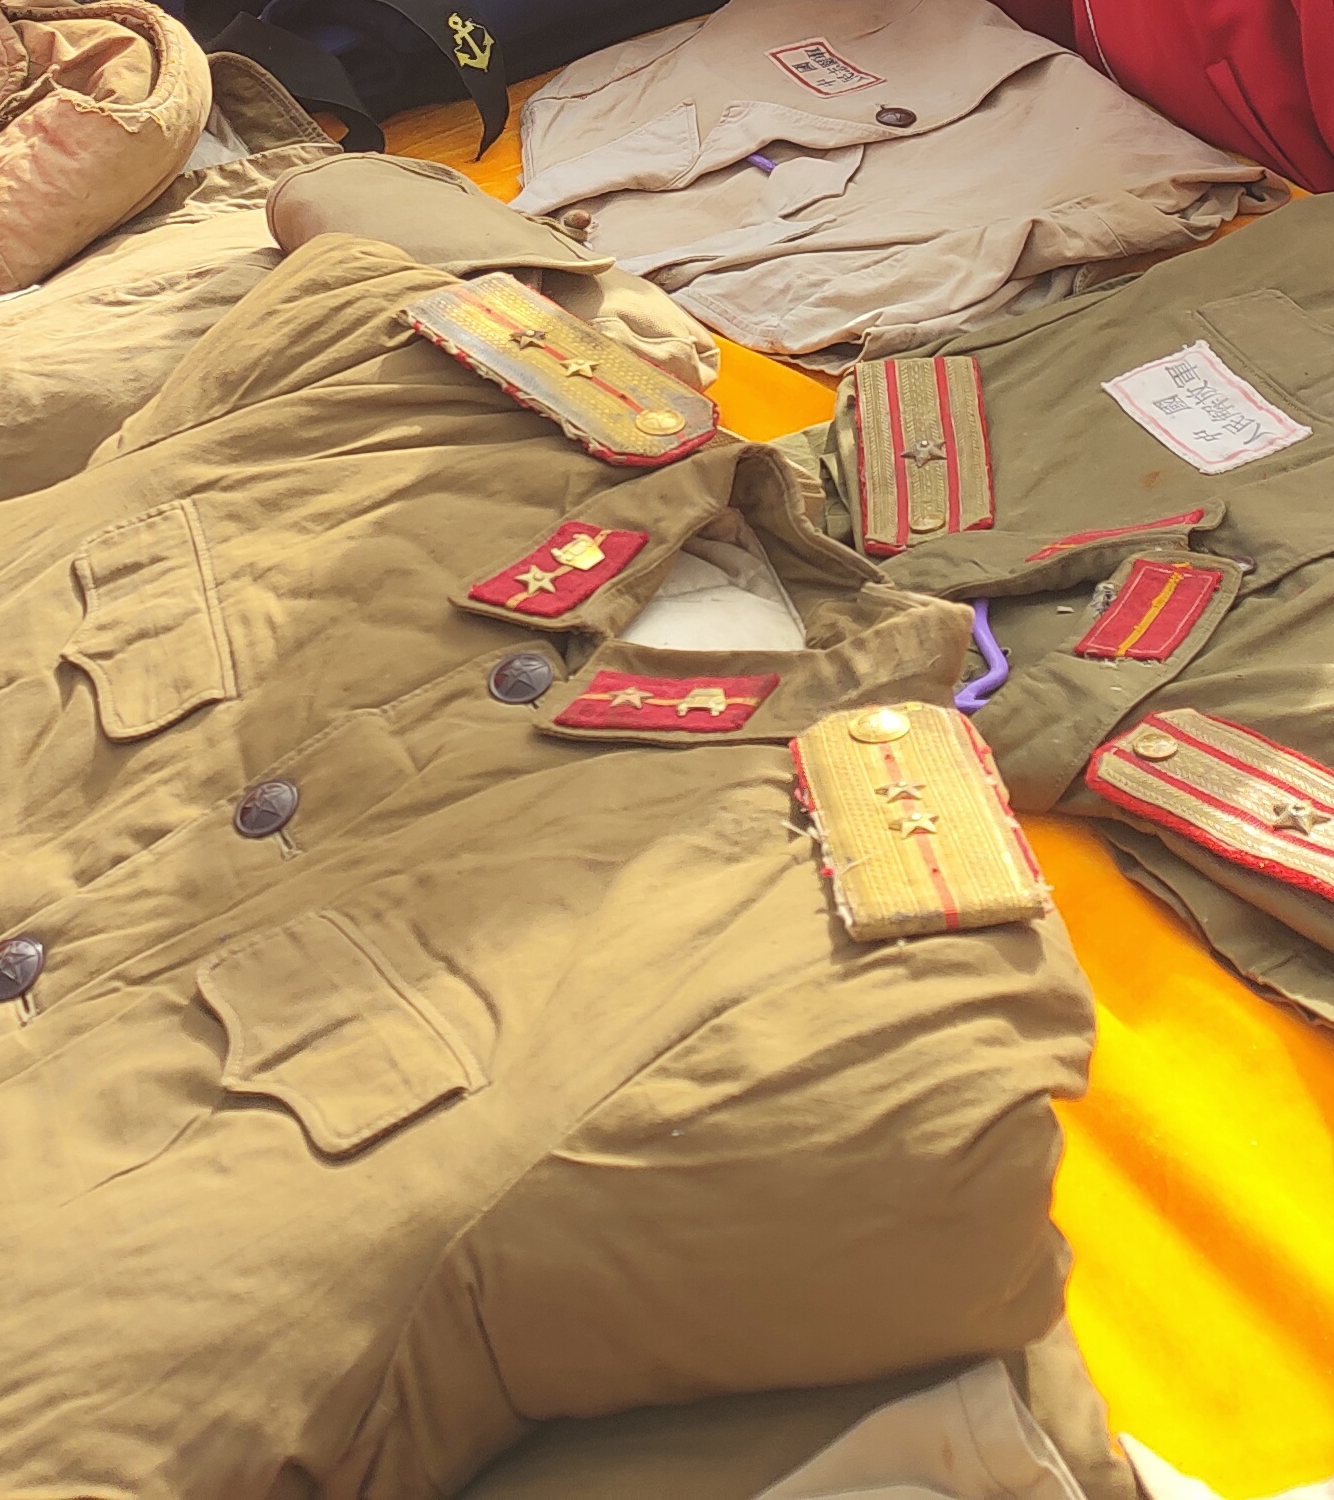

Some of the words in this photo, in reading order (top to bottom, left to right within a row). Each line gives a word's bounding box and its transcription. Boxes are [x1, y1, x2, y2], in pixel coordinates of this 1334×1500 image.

[1153, 393, 1223, 443] 中國
[1165, 359, 1275, 445] 人民解放軍
